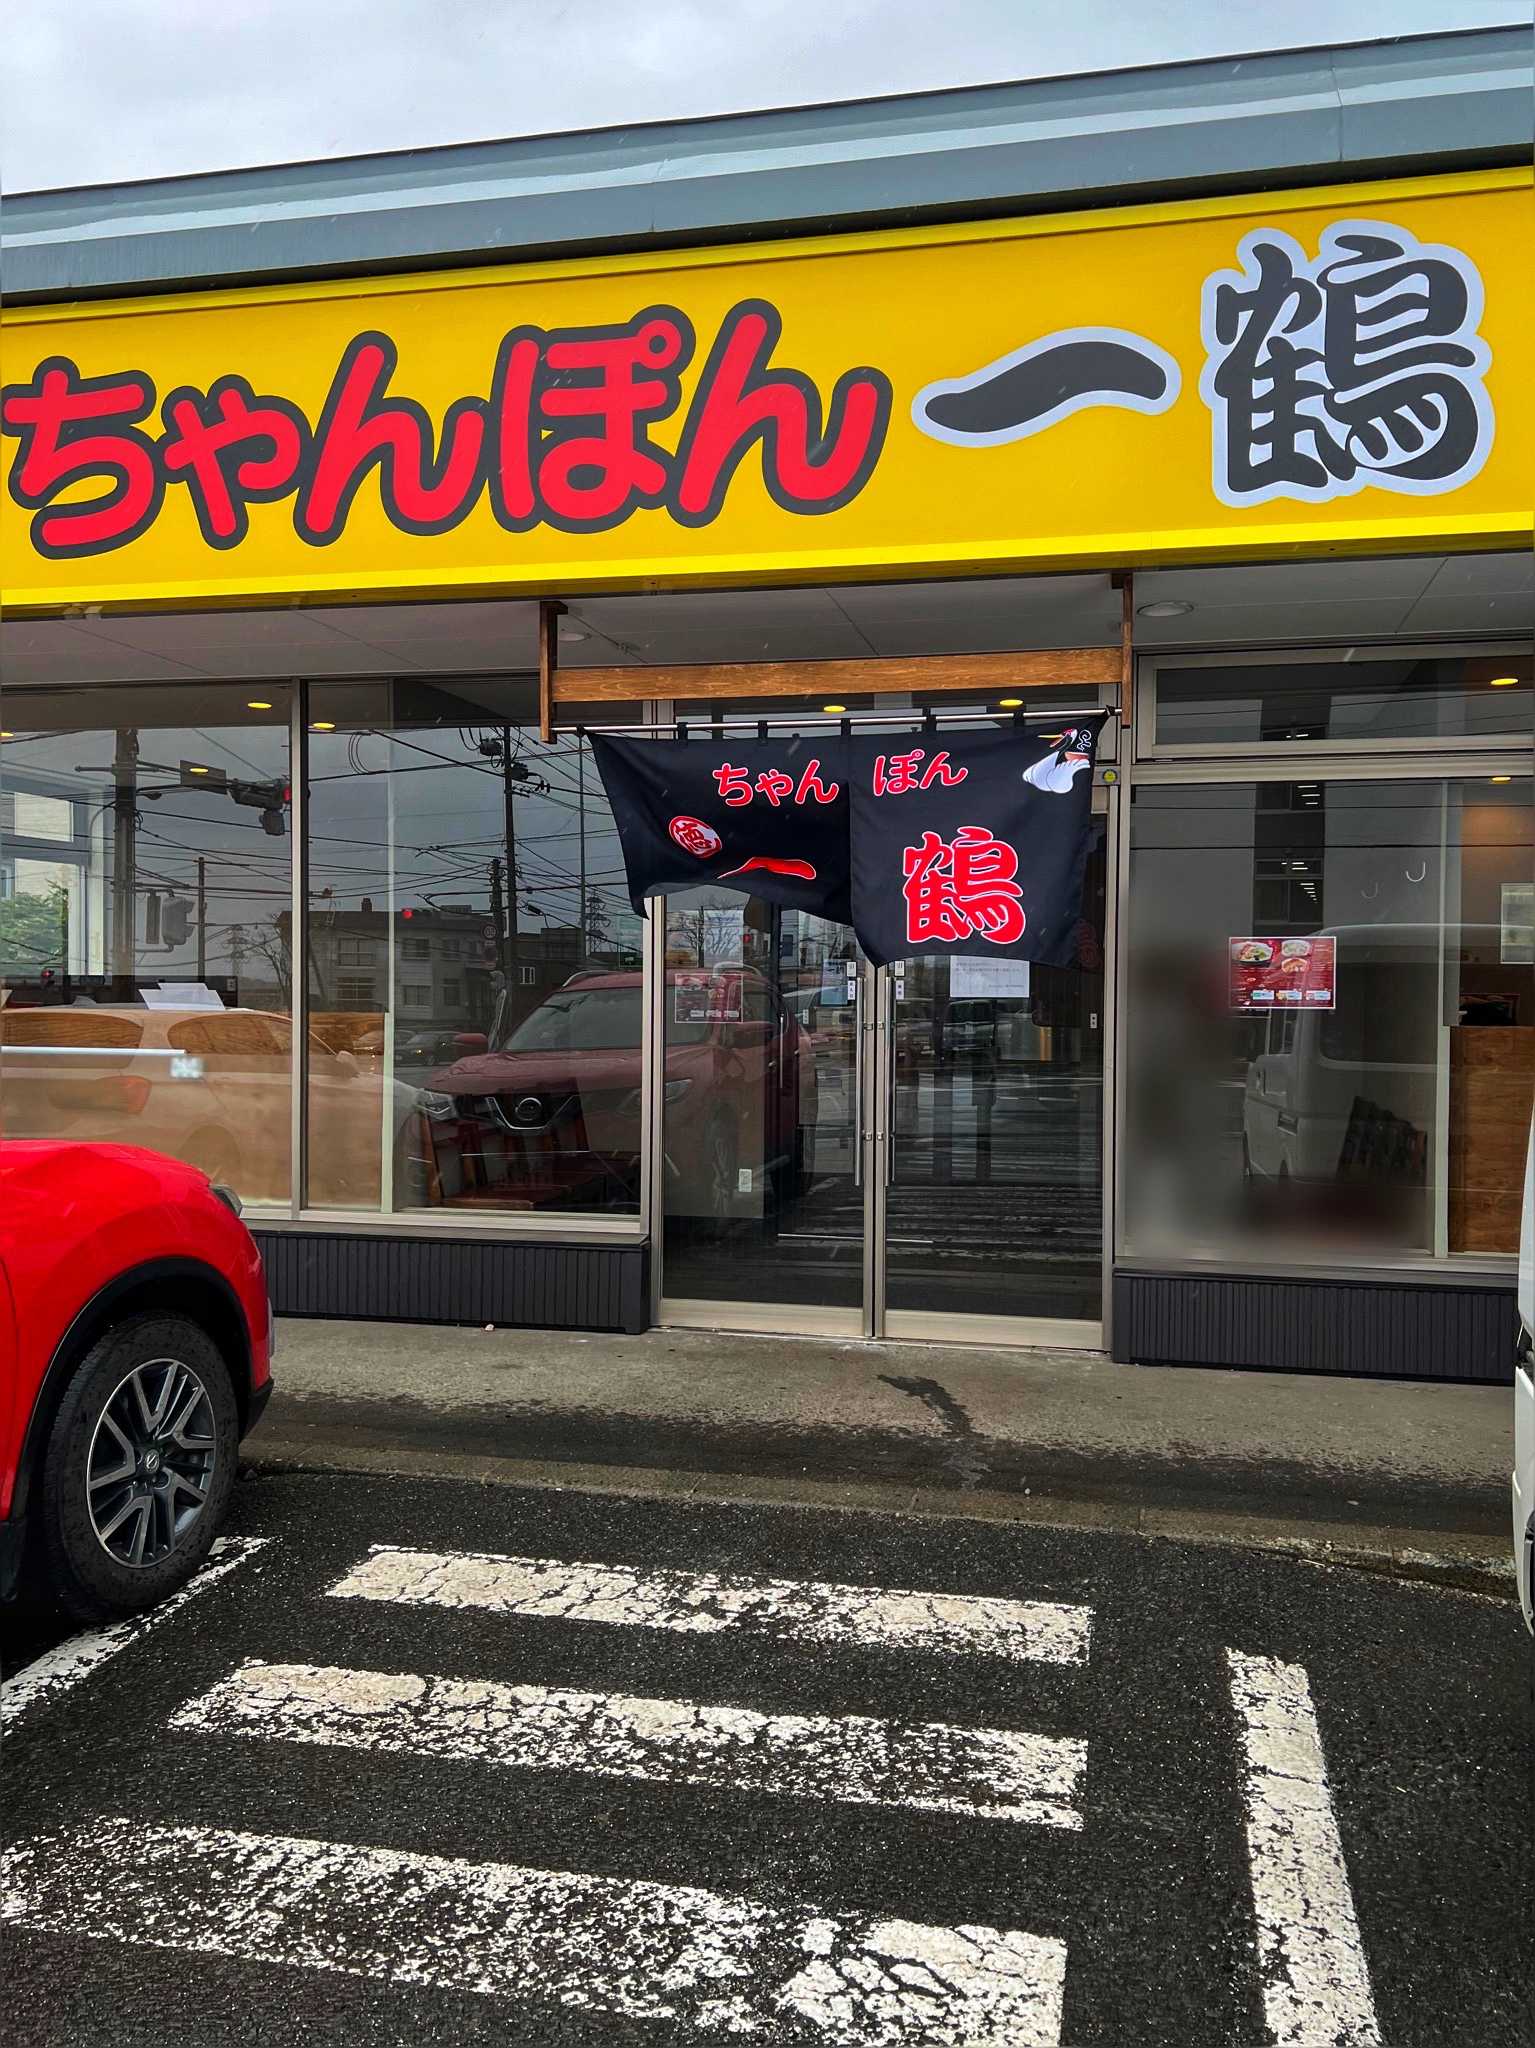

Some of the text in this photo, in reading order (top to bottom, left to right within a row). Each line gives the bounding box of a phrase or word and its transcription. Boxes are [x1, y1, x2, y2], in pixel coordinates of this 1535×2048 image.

[0, 299, 893, 560] ちゃんぽん
